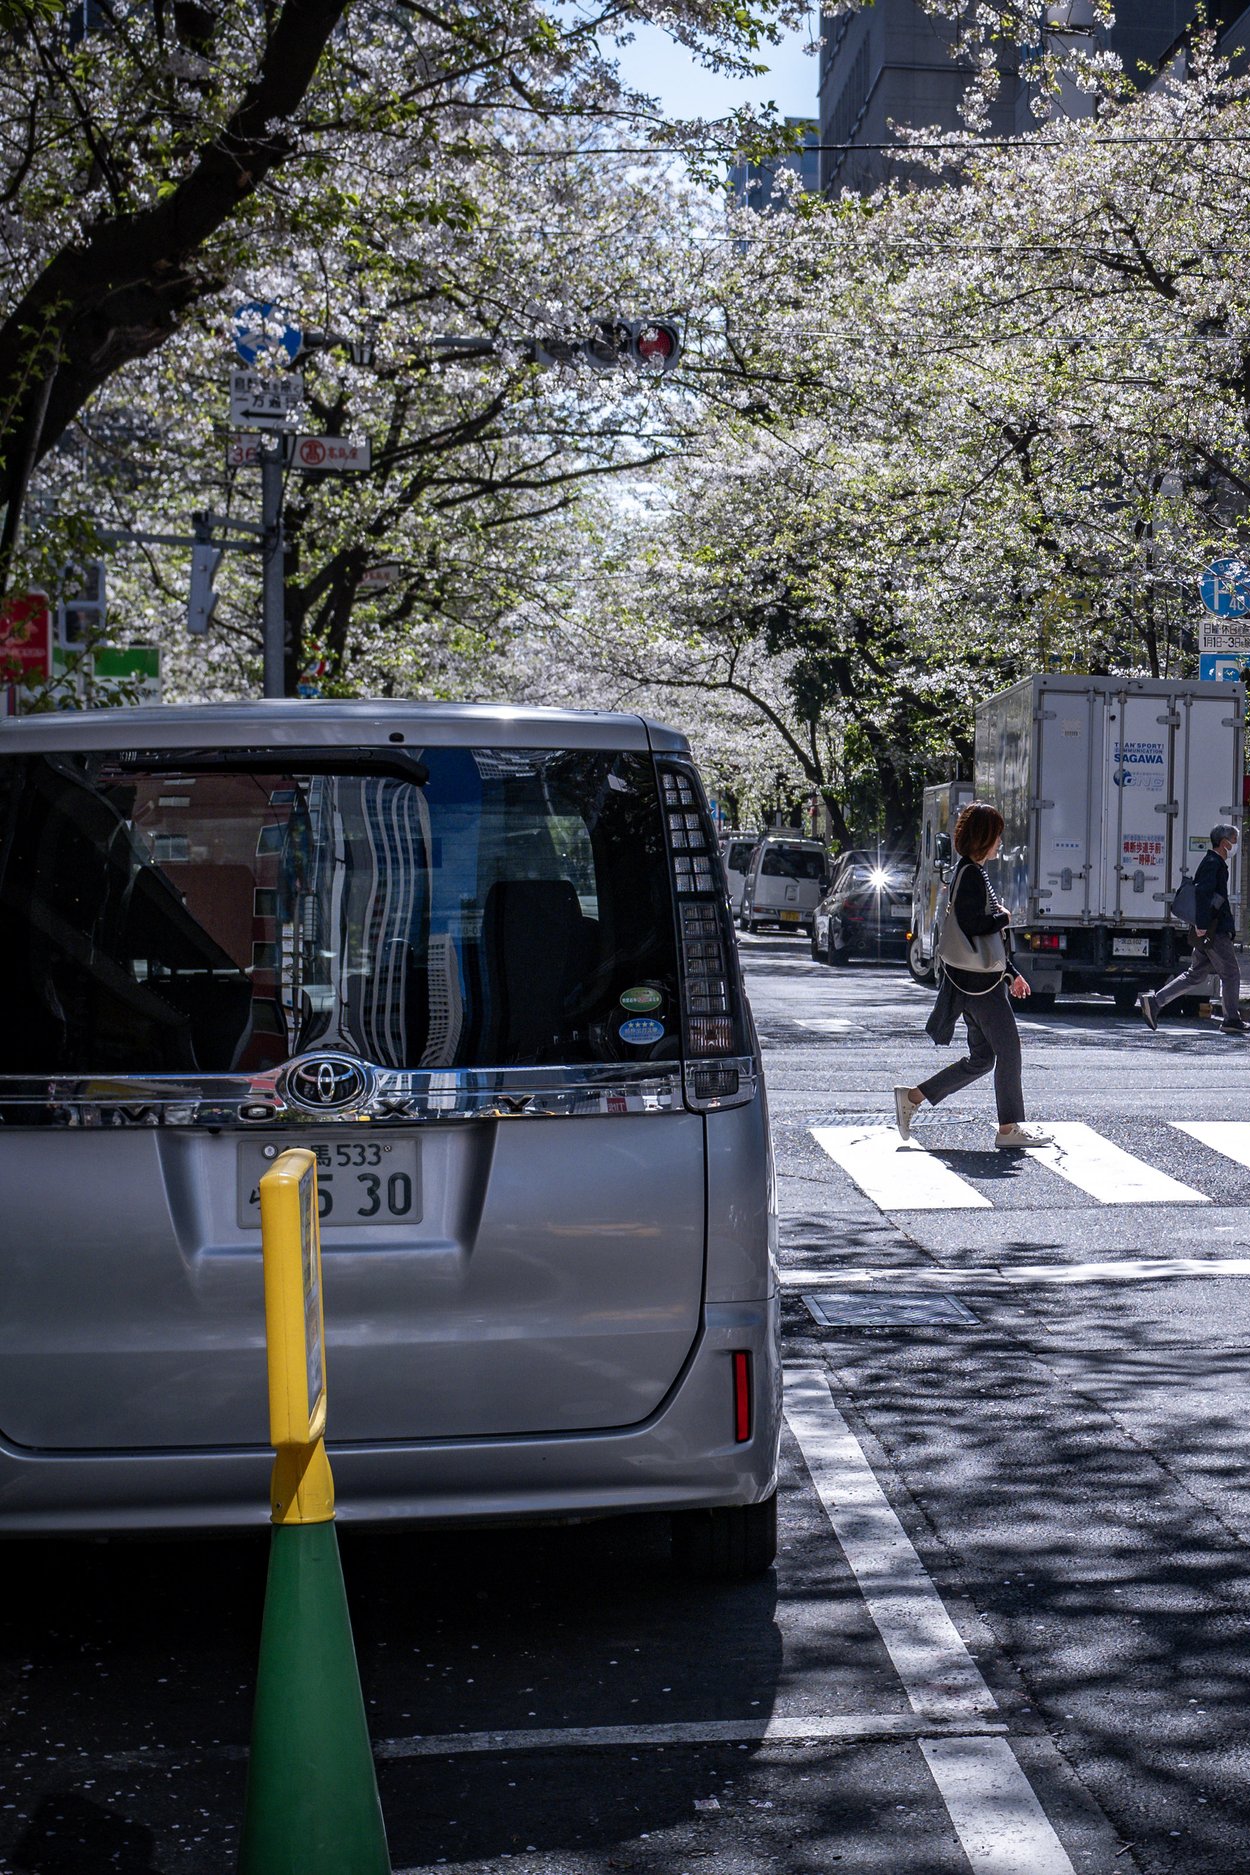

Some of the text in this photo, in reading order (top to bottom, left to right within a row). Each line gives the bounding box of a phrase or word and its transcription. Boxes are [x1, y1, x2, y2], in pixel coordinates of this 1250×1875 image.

[1114, 753, 1163, 764] SAGAWA
[337, 1144, 381, 1167] 533
[357, 1172, 412, 1217] 30
